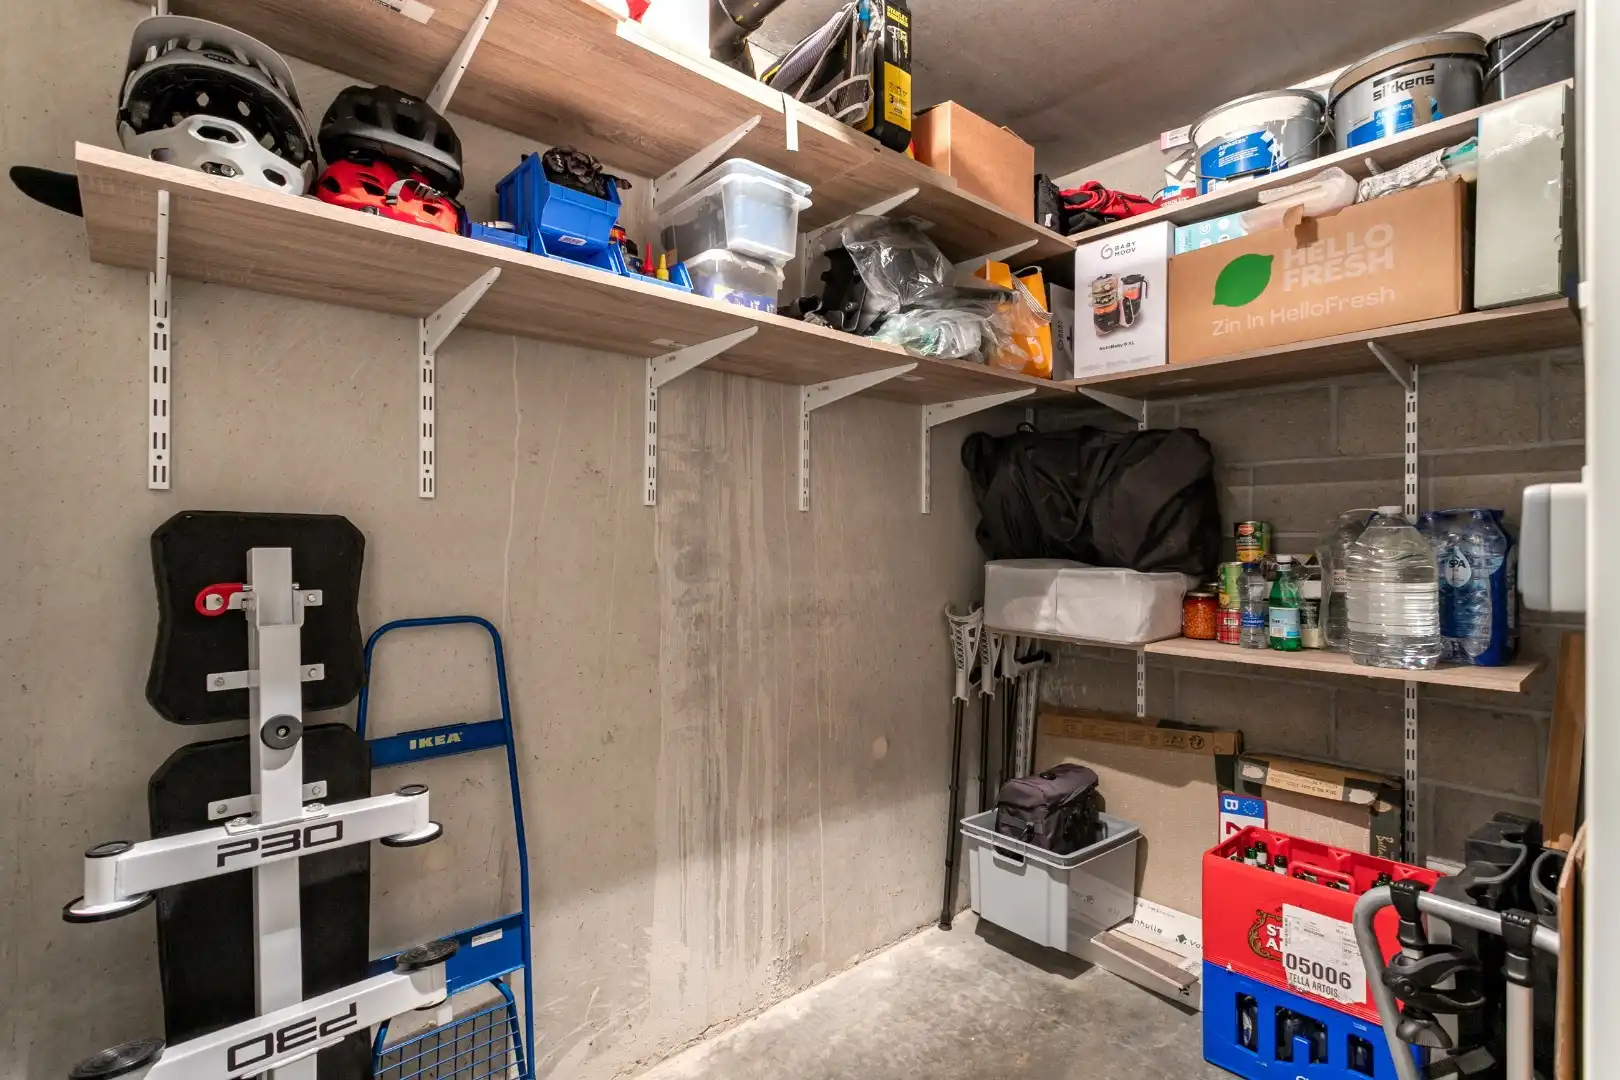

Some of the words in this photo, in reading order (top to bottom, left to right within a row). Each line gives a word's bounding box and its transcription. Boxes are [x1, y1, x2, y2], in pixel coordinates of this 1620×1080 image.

[1115, 241, 1136, 251] BABY
[1115, 247, 1136, 256] MOOV
[1284, 222, 1394, 270] HELLO
[1283, 245, 1394, 292] FRESH
[1212, 319, 1241, 337] Zin
[1270, 286, 1395, 325] HelloFresh
[1449, 559, 1467, 569] SPA
[410, 732, 462, 750] IKEA
[1224, 798, 1239, 811] B
[217, 820, 343, 868] P30
[1286, 952, 1352, 990] 05006
